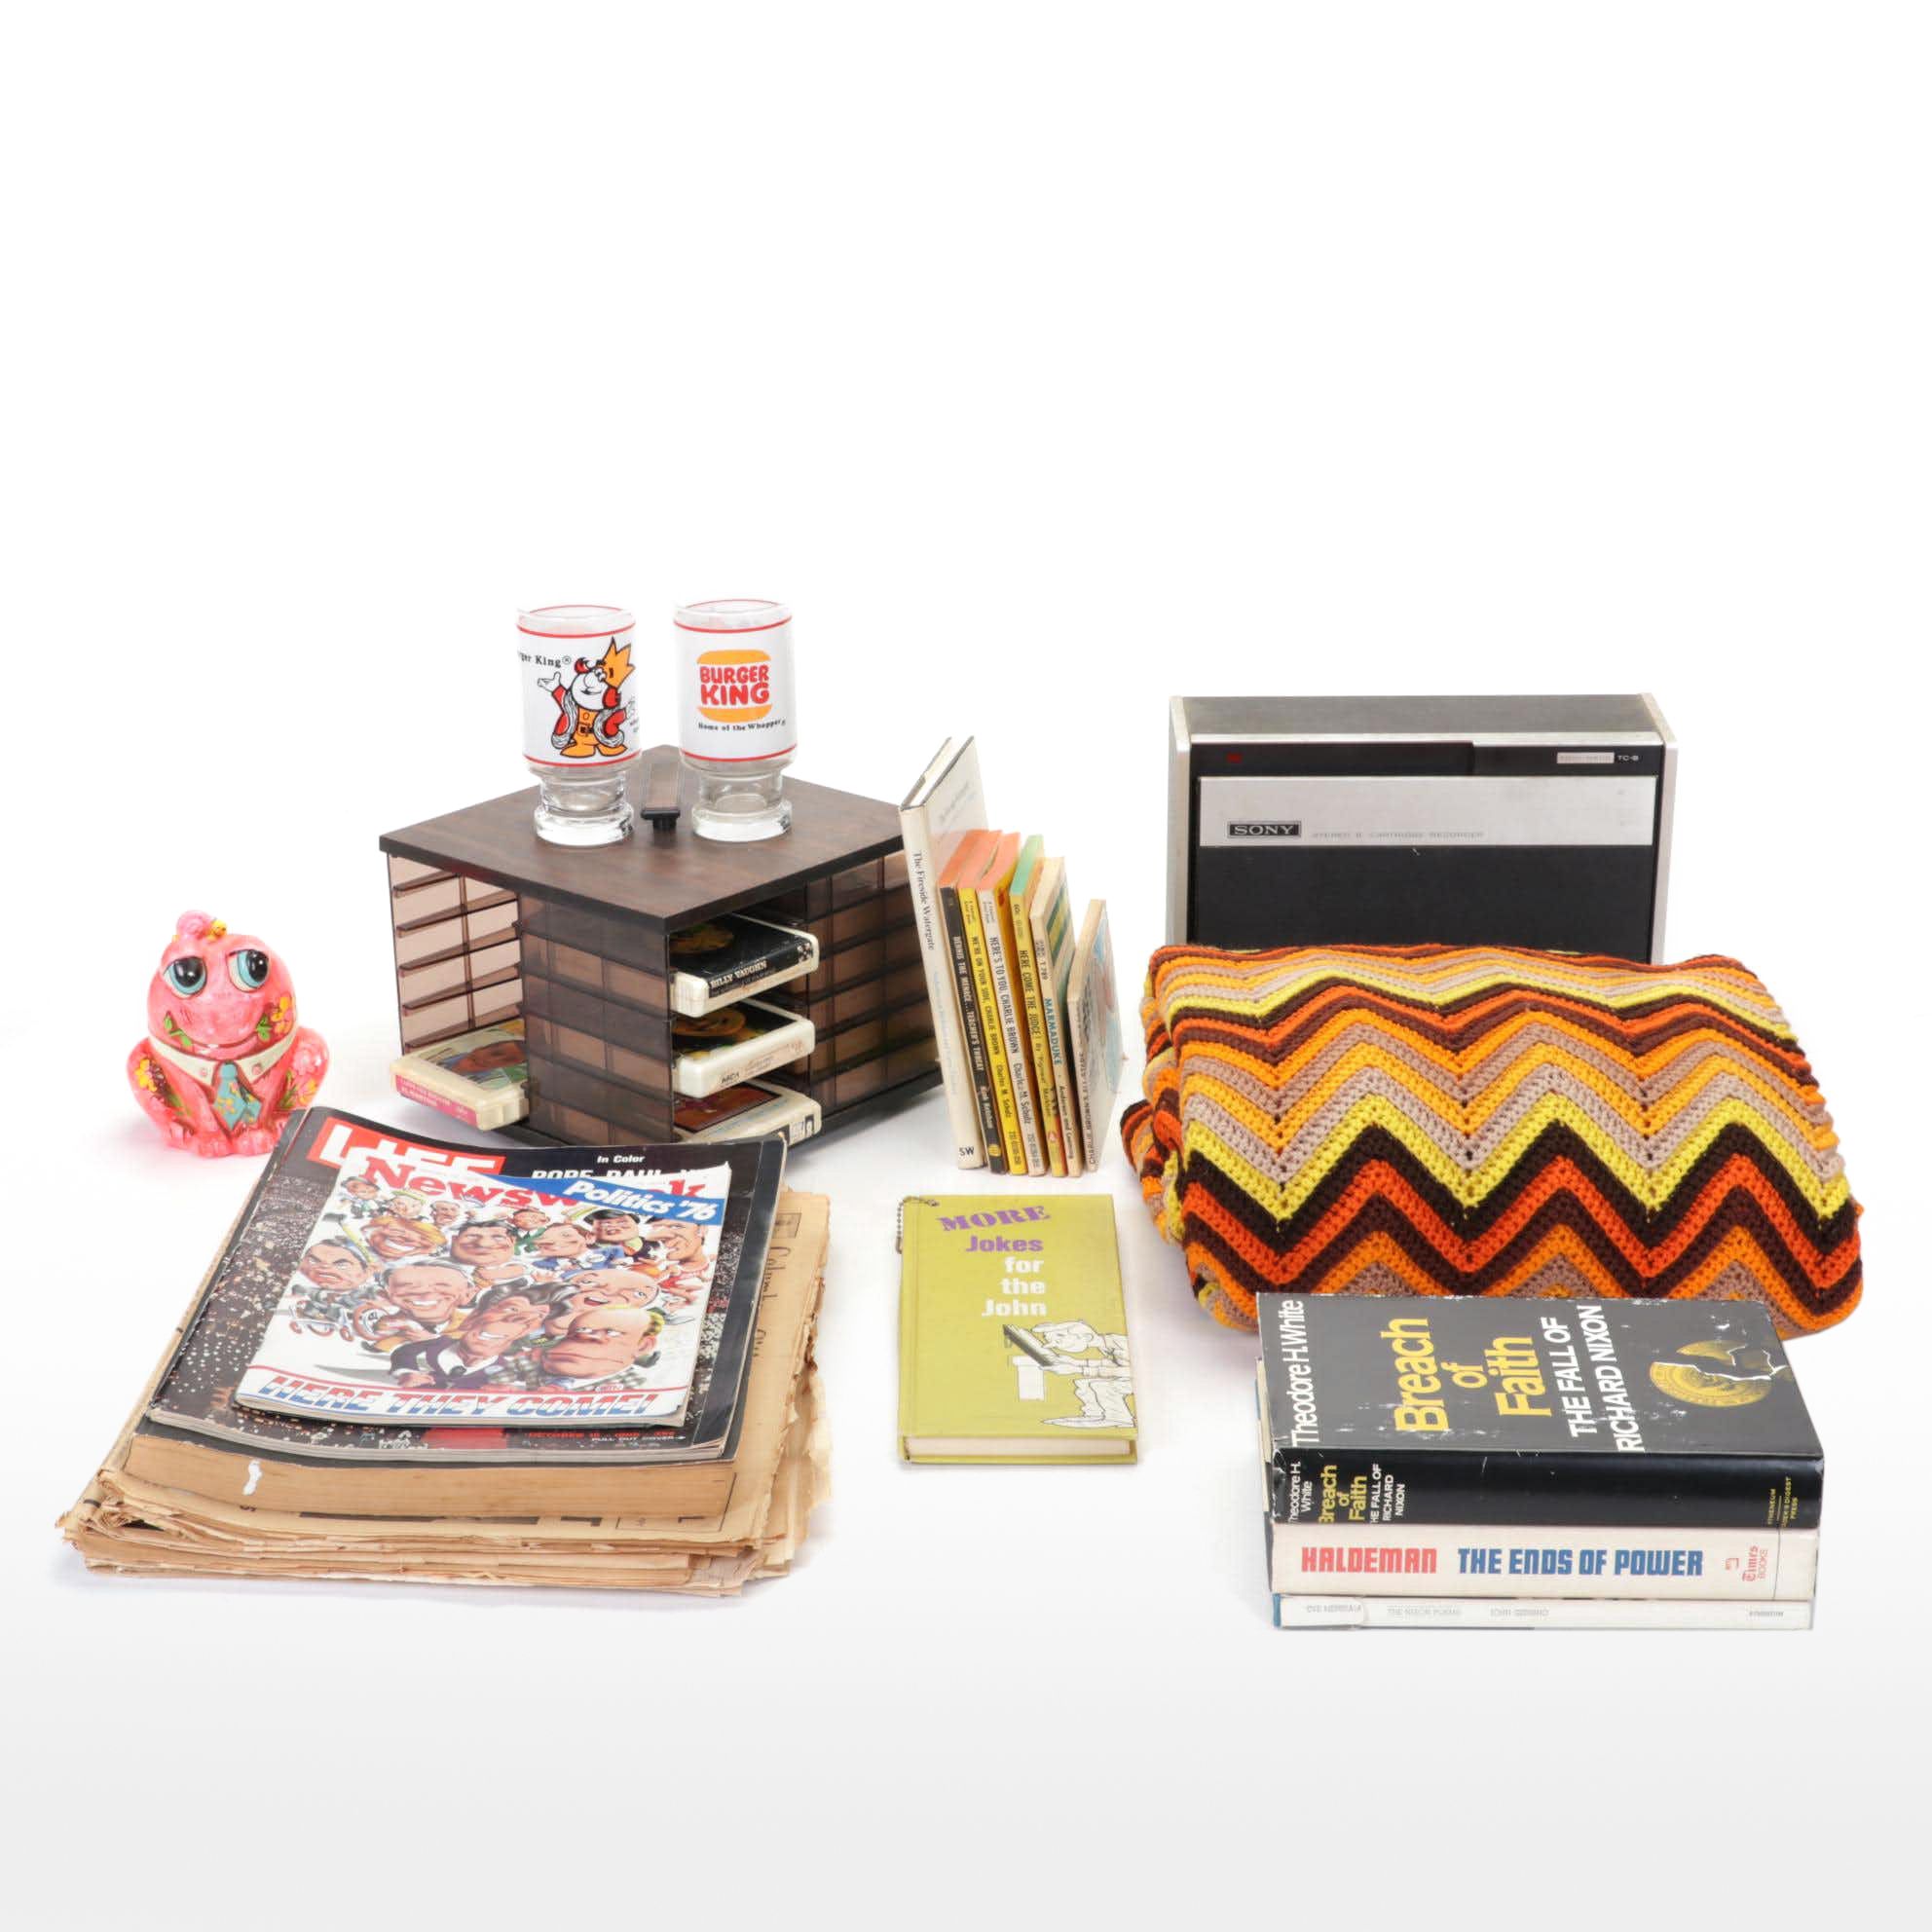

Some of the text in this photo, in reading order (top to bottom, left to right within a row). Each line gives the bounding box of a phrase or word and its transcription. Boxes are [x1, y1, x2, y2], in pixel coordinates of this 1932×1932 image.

[699, 665, 769, 684] BURGER
[700, 682, 769, 705] KING
[698, 722, 718, 730] Home
[1234, 825, 1294, 836] SONY
[911, 851, 936, 950] The Fireside Watergate
[988, 936, 1002, 963] HERE'S
[1019, 948, 1030, 968] HERE
[957, 961, 967, 975] THE
[994, 964, 1005, 975] TO
[1022, 971, 1034, 992] COME
[999, 993, 1015, 1024] CHARLIE
[1025, 995, 1037, 1009] THE
[1006, 1025, 1020, 1054] BROWN
[1044, 997, 1061, 1064] MARMADUKE
[597, 1155, 646, 1164] In Color
[959, 1146, 975, 1157] SW
[563, 1180, 676, 1214] Politics
[935, 1206, 1052, 1232] MORE
[965, 1236, 1044, 1252] Jokes
[1004, 1256, 1045, 1274] for
[1000, 1278, 1047, 1295] the
[982, 1299, 1047, 1317] John
[1381, 1317, 1449, 1431] Breach
[1441, 1360, 1488, 1389] of
[1484, 1336, 1552, 1417] Faith
[1540, 1317, 1598, 1438] THE FALL OF
[1577, 1305, 1646, 1452] RICHARD NIXON
[258, 1376, 658, 1416] HERE THEY COME!
[1286, 1363, 1319, 1447] Theodore
[1288, 1476, 1301, 1524] heodore
[1301, 1480, 1313, 1512] White
[1336, 1491, 1350, 1507] of
[1349, 1475, 1367, 1521] Faith
[1370, 1463, 1382, 1524] HE FALL OF
[1383, 1474, 1393, 1521] RICHARD
[1394, 1483, 1405, 1516] NIXON
[1301, 1546, 1703, 1577] HALDEMAN THE ENDS OF POWER
[1742, 1545, 1759, 1581] Times
[1758, 1549, 1768, 1579] BOOKS
